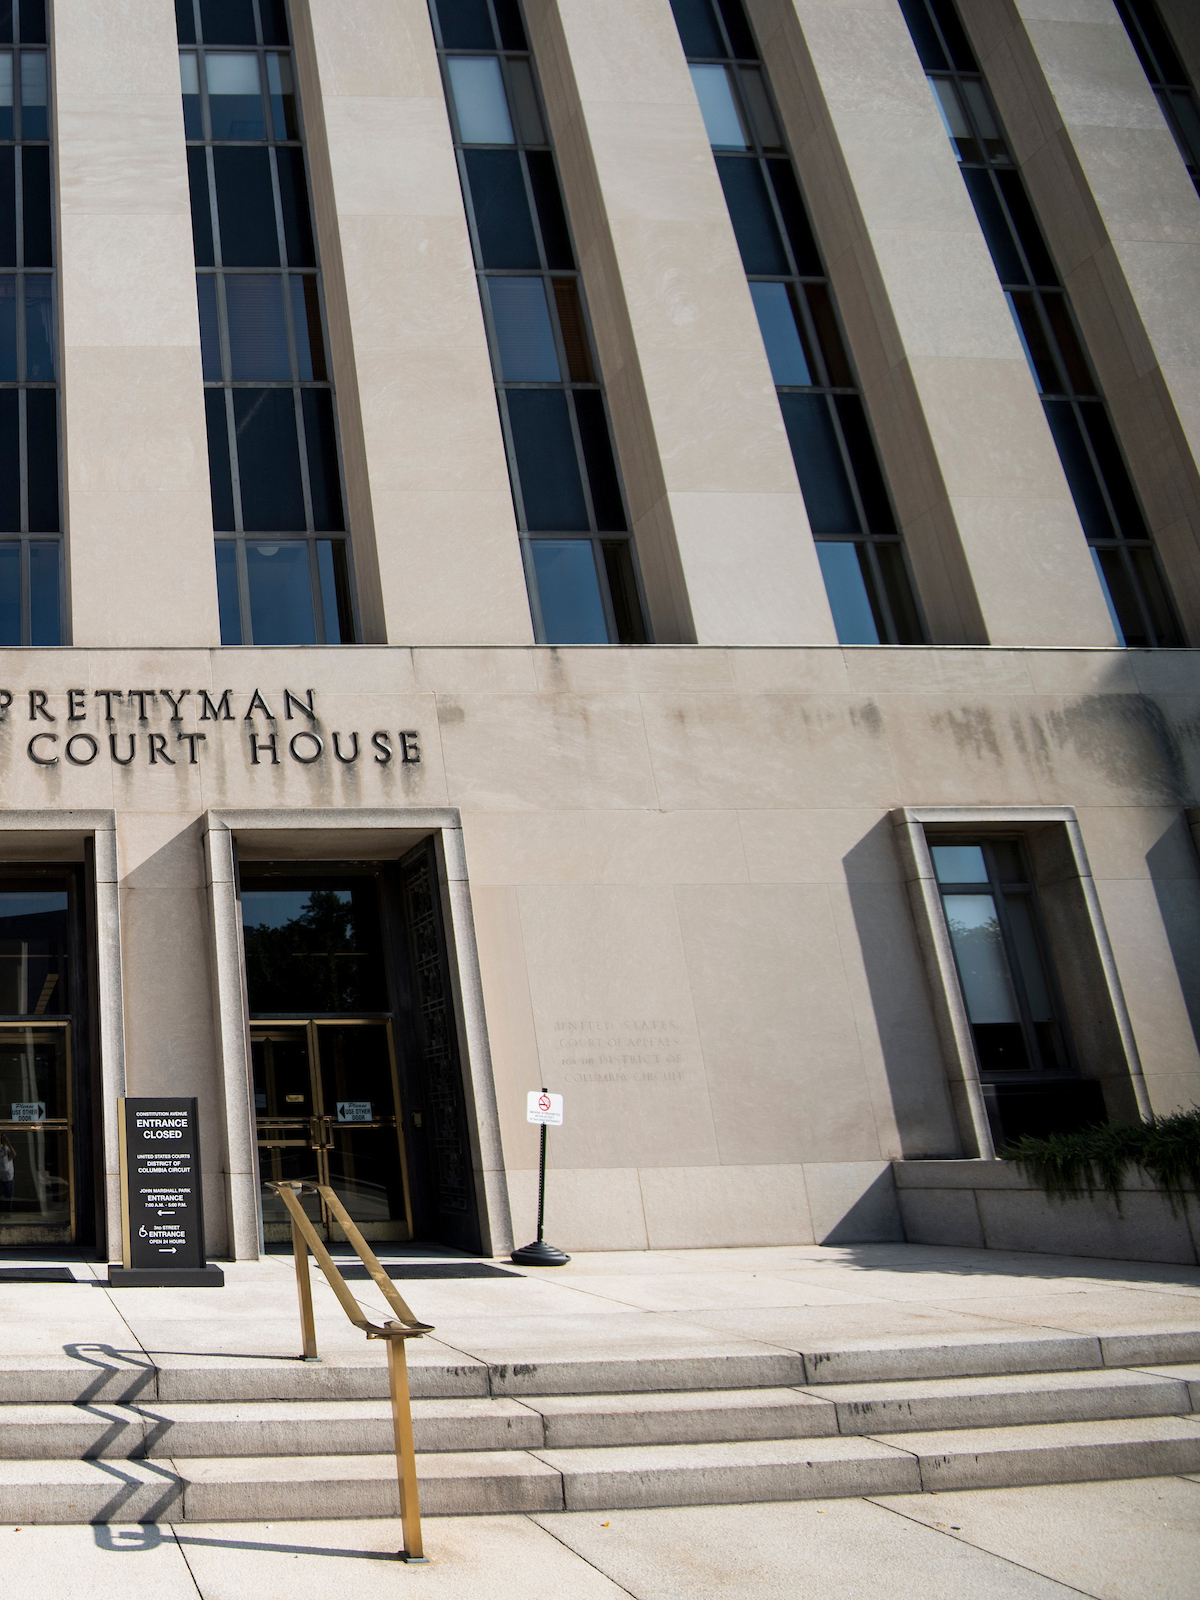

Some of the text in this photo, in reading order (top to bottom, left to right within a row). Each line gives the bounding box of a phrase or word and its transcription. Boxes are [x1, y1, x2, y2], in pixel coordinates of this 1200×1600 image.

[27, 732, 206, 766] COURT
[249, 730, 421, 766] HOUSE
[556, 1021, 677, 1030] UNITED STATES
[560, 1038, 679, 1048] COURT OF APPEALS
[600, 1054, 661, 1064] DISTRICT
[666, 1054, 682, 1064] OF
[564, 1072, 684, 1082] COLUMBIA CIRCUIT
[136, 1119, 188, 1128] ENTRANCE
[143, 1130, 182, 1139] CLOSED
